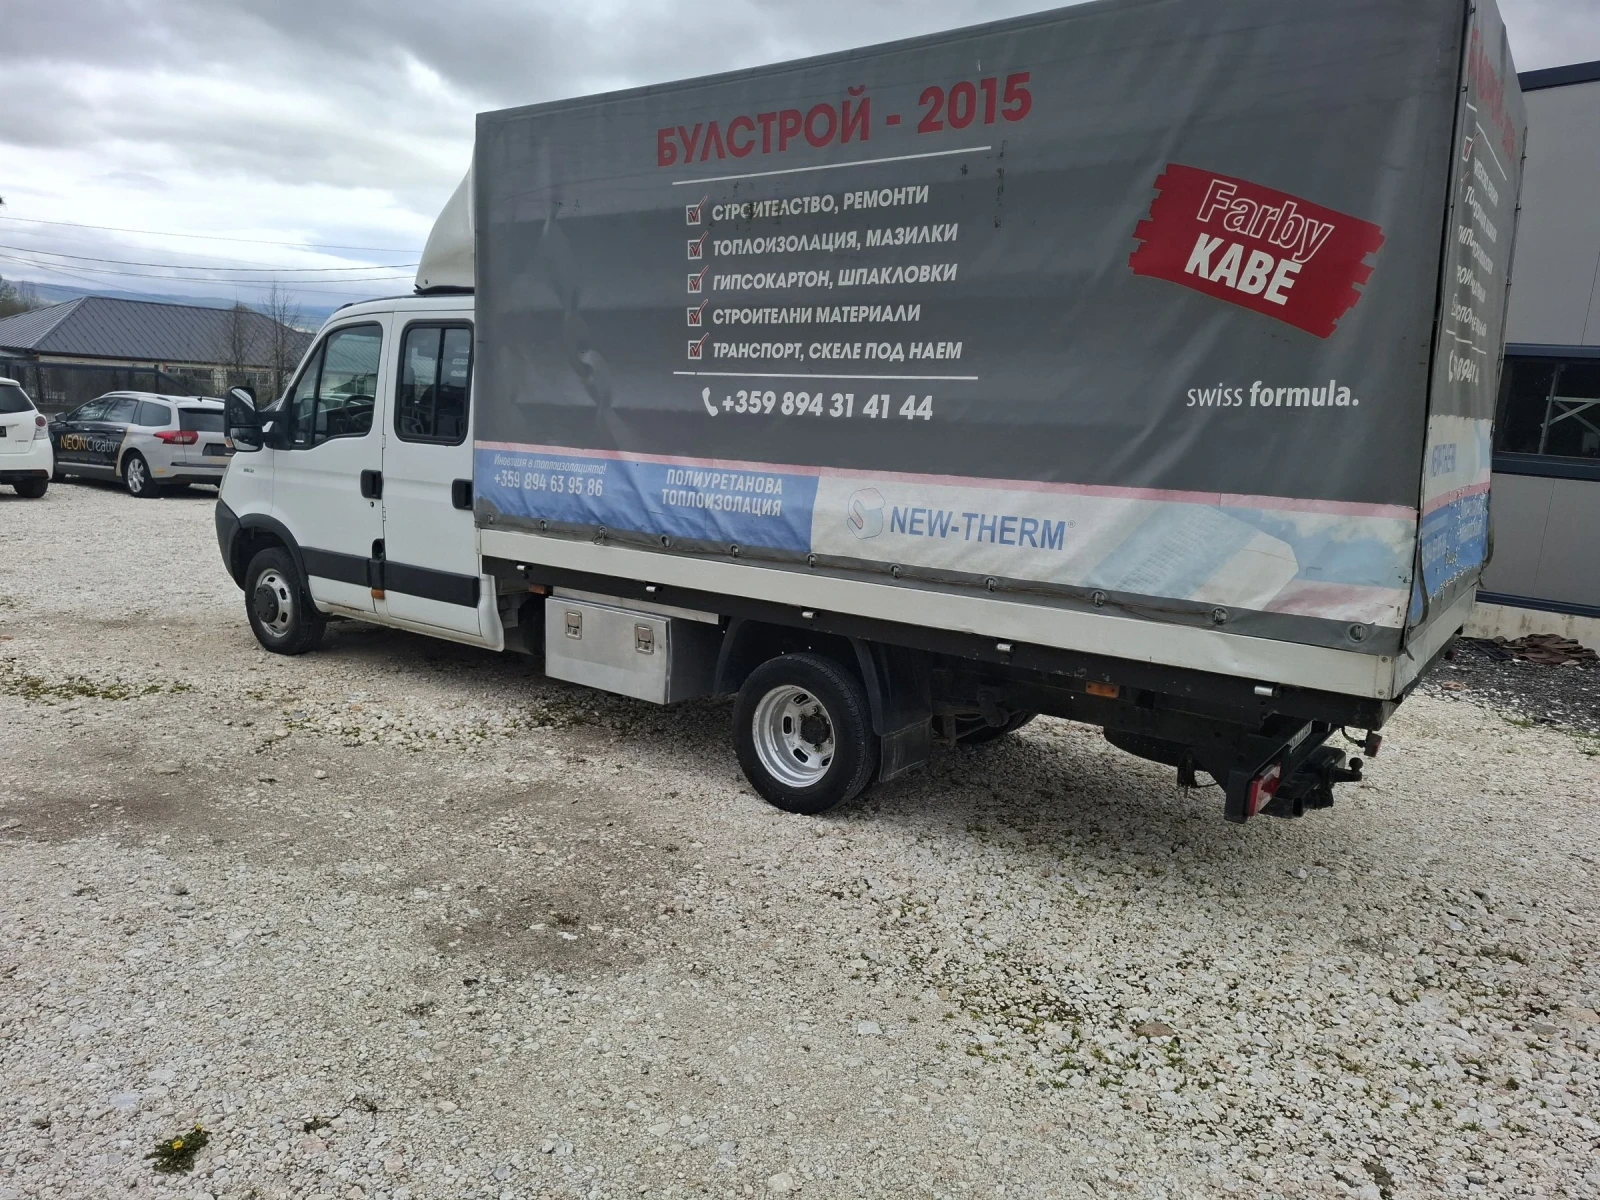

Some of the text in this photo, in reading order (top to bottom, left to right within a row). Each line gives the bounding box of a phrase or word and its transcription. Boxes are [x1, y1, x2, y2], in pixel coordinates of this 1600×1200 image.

[657, 71, 1032, 167] БУЛСТРОЙ - 2015
[711, 185, 929, 221] СТРОИТЕЛСТВО, РЕМОНТИ
[1197, 179, 1335, 263] Farby
[713, 223, 959, 257] ТОПЛОИЗОЛАЦИЯ, МАЗИЛКИ
[713, 263, 958, 290] ГИПСОКАРТОН, ШПАКЛОВКИ
[1184, 232, 1302, 306] KABE
[712, 304, 921, 325] СТРОИТЕЛНИ МАТЕРИАЛИ
[713, 342, 962, 361] ТРАНСПОРТ, СКЕЛЕ ПОД НАЕМ
[722, 390, 933, 420] +359 894 31 41 44
[1186, 379, 1360, 407] swiss formula.
[494, 470, 603, 497] +359 894 63 95 86
[666, 468, 783, 495] ПОЛИУРЕТАНОВА
[661, 488, 782, 517] ТОПЛОИЗОЛАЦИЯ
